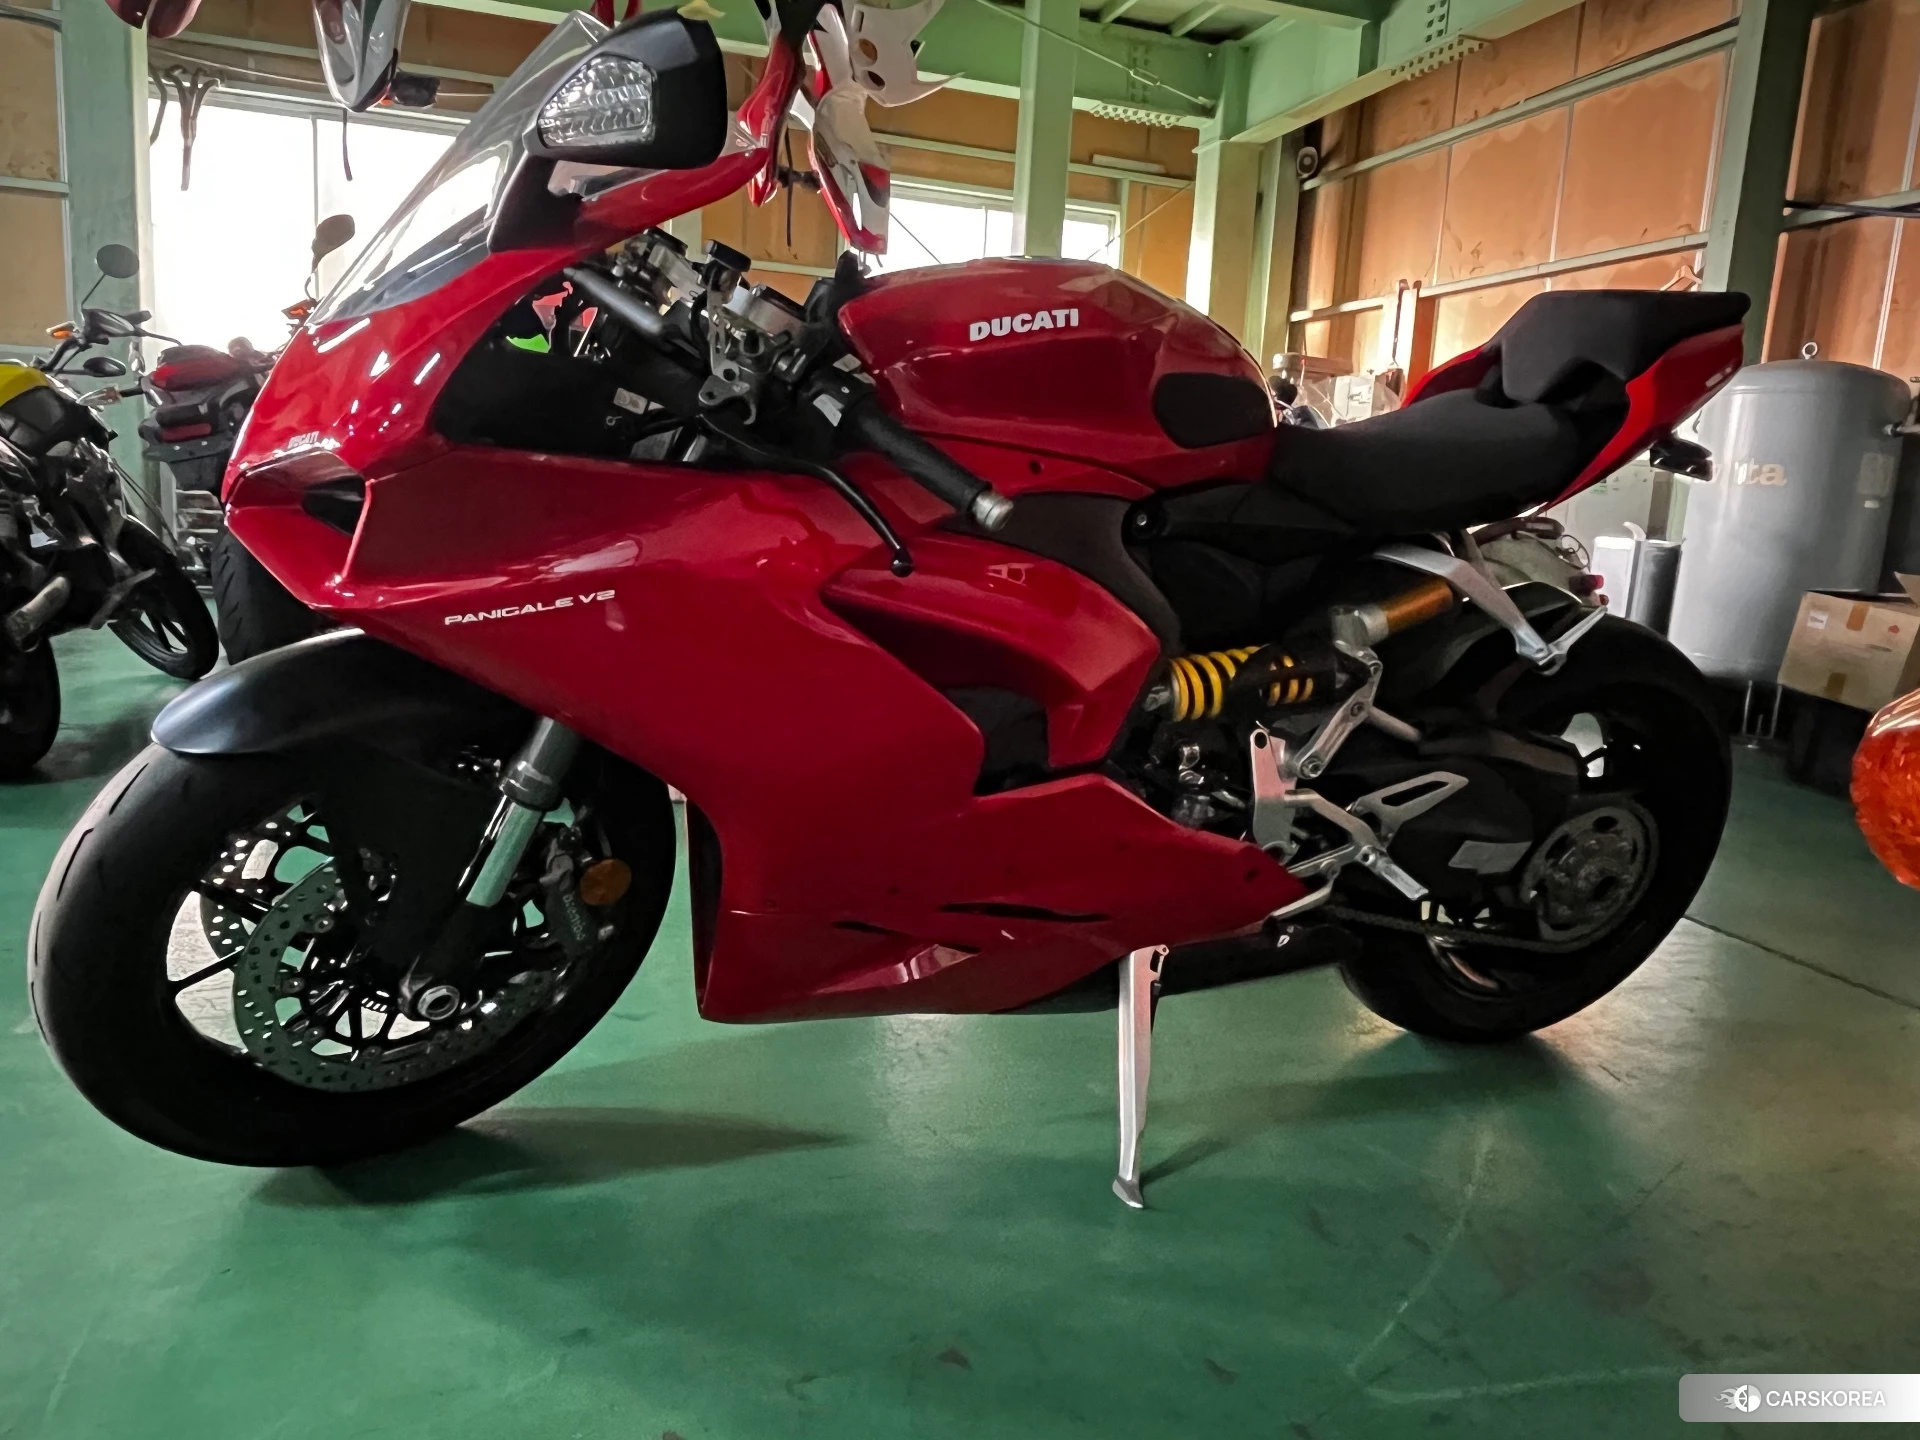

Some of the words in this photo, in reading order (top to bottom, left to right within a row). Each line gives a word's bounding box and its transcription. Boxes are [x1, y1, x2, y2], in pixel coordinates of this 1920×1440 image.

[969, 308, 1079, 341] DUCATI
[444, 596, 574, 626] PANIGALE
[578, 589, 616, 604] V2
